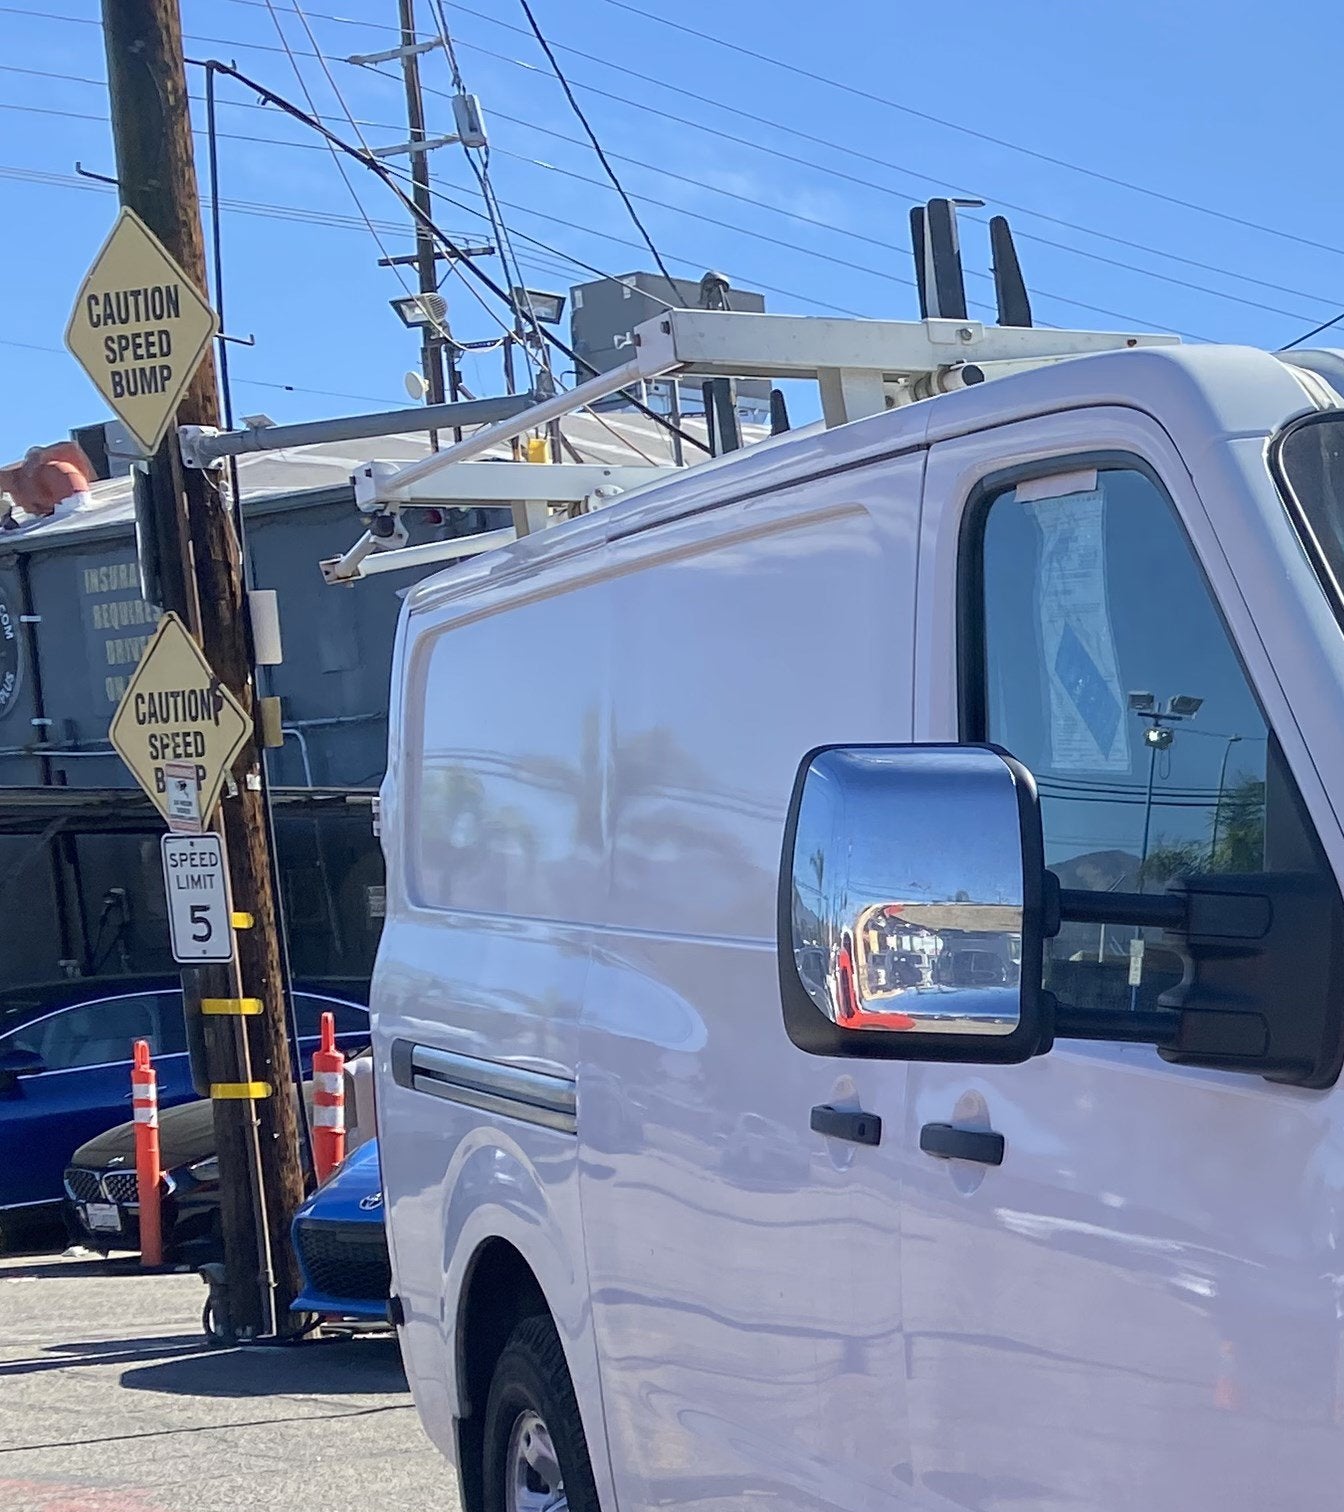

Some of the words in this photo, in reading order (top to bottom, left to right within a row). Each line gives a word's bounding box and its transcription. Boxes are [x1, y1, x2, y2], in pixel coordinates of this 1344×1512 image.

[87, 284, 180, 328] CAUTION
[104, 329, 172, 364] SPEED
[111, 364, 172, 399] BUMP
[84, 563, 137, 594] INSURA
[134, 689, 213, 726] CAUTION
[148, 730, 206, 760] SPEED
[154, 764, 207, 793] BP
[169, 851, 219, 869] SPEED
[176, 873, 216, 891] LIMIT
[189, 905, 213, 943] 5
